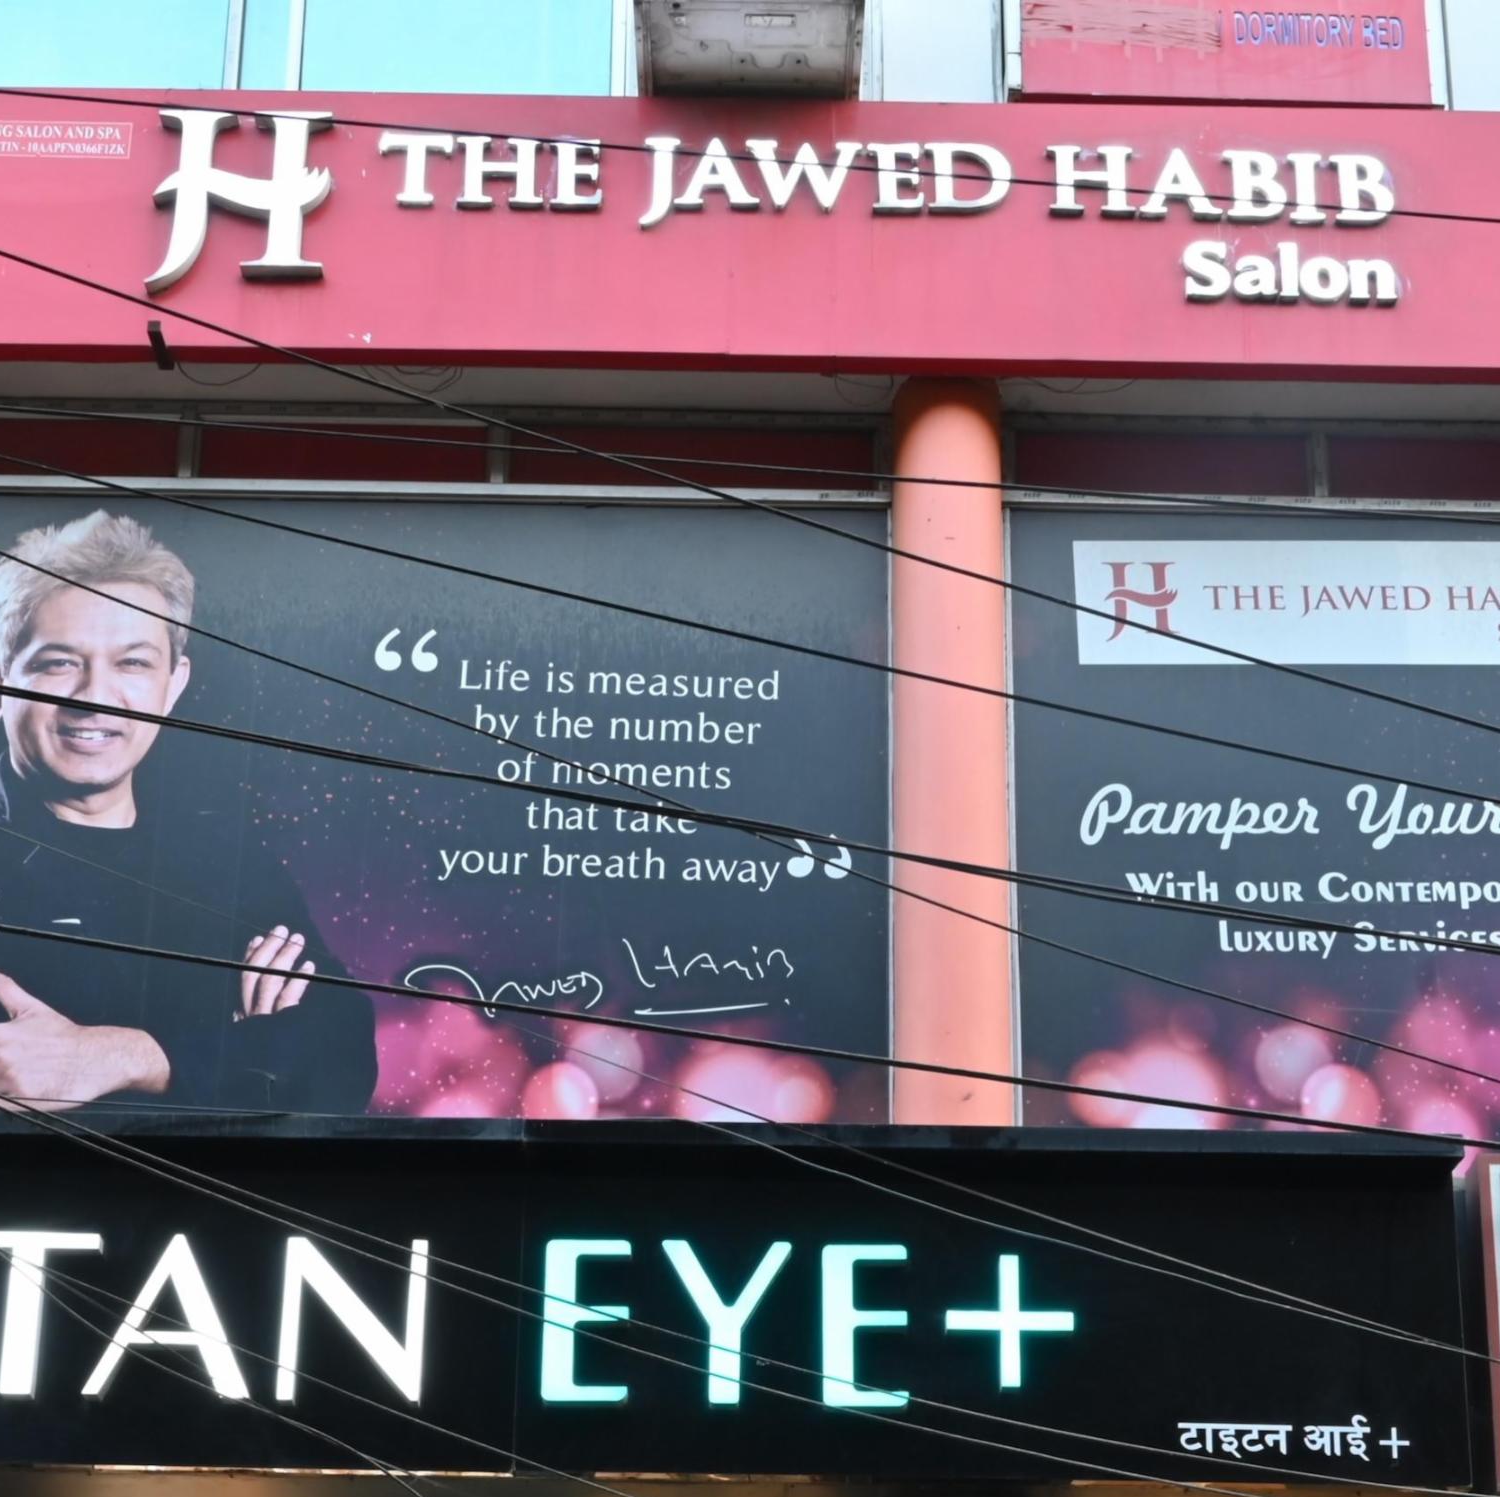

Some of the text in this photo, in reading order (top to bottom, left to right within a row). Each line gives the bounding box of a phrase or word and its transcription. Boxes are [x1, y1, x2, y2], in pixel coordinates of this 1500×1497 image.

[1233, 11, 1404, 50] DORMITORY BED
[16, 125, 63, 139] SALON
[65, 126, 94, 140] AND
[96, 127, 121, 140] SPA
[380, 130, 603, 211] THE
[637, 135, 1011, 230] JAWED
[1045, 145, 1396, 228] HABIB
[1181, 240, 1398, 309] Salon
[1203, 584, 1287, 612] THE
[1300, 585, 1432, 618] JAWED
[459, 660, 781, 702] Life is measured
[473, 705, 762, 746] by the number
[498, 752, 732, 790] of moments
[525, 800, 698, 835] that take
[1080, 783, 1321, 850] Pamper
[438, 844, 781, 892] your breath away
[1176, 1422, 1294, 1460] टाइटन
